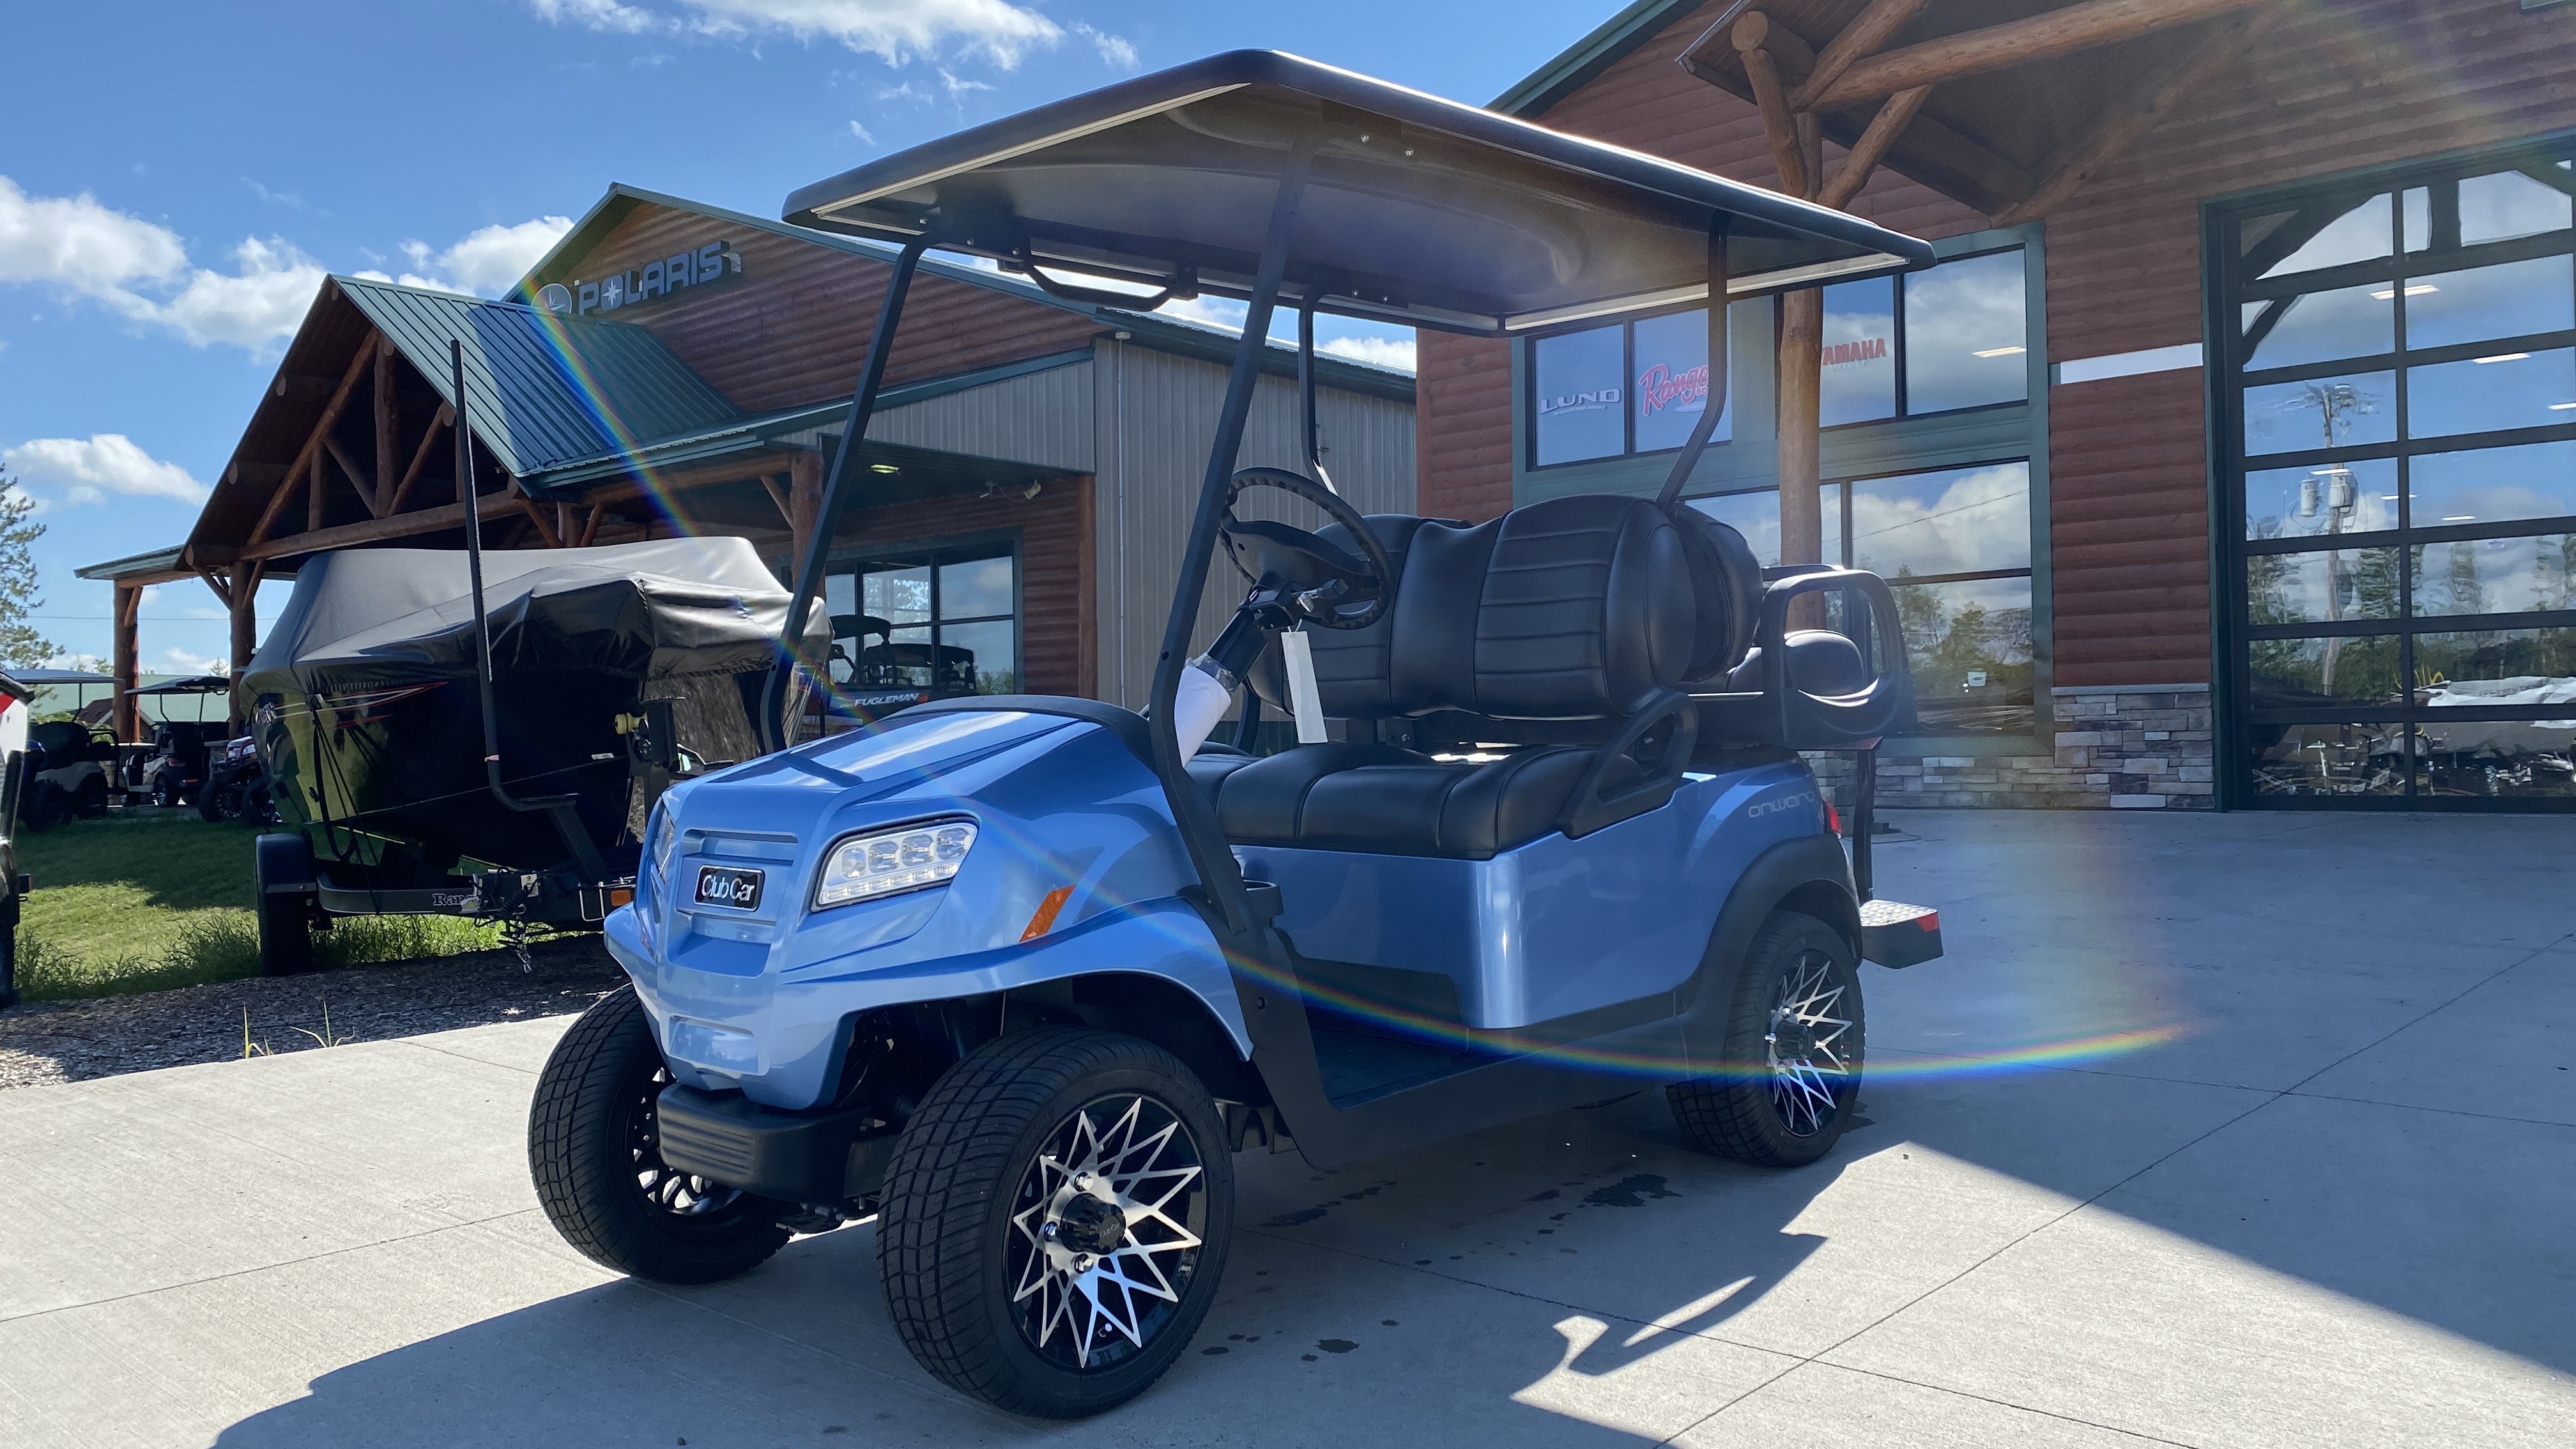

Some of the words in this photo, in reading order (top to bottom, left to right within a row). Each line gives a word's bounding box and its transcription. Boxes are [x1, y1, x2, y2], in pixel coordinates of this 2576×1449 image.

[578, 240, 728, 315] POLARIS
[1822, 338, 1887, 365] AMAHA
[1539, 388, 1620, 414] LUND
[1639, 364, 1708, 416] Range
[854, 693, 919, 707] FUGLEMAN
[701, 874, 730, 899] Club
[730, 877, 755, 901] Car
